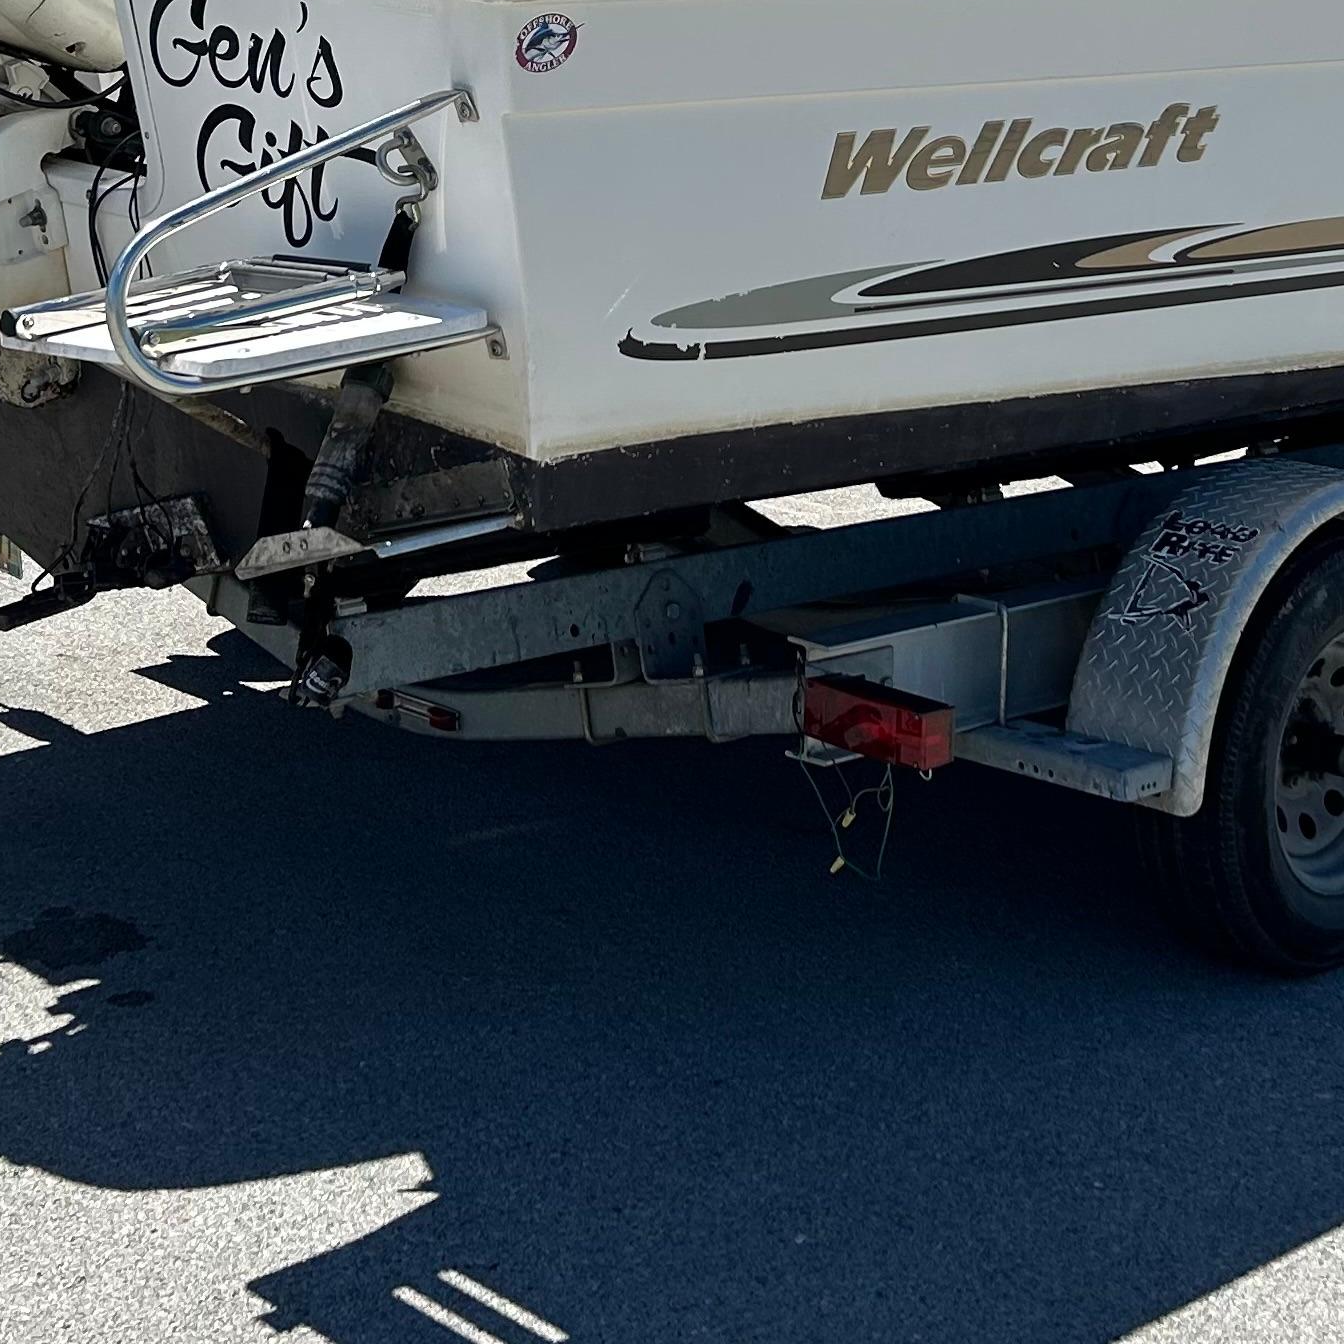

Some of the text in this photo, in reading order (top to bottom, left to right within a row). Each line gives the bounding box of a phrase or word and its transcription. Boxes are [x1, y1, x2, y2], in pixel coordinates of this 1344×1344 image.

[520, 15, 573, 40] OFFSHORE
[524, 54, 567, 72] ANGLER
[197, 103, 380, 249] Gift
[820, 102, 1220, 200] Wellcraft
